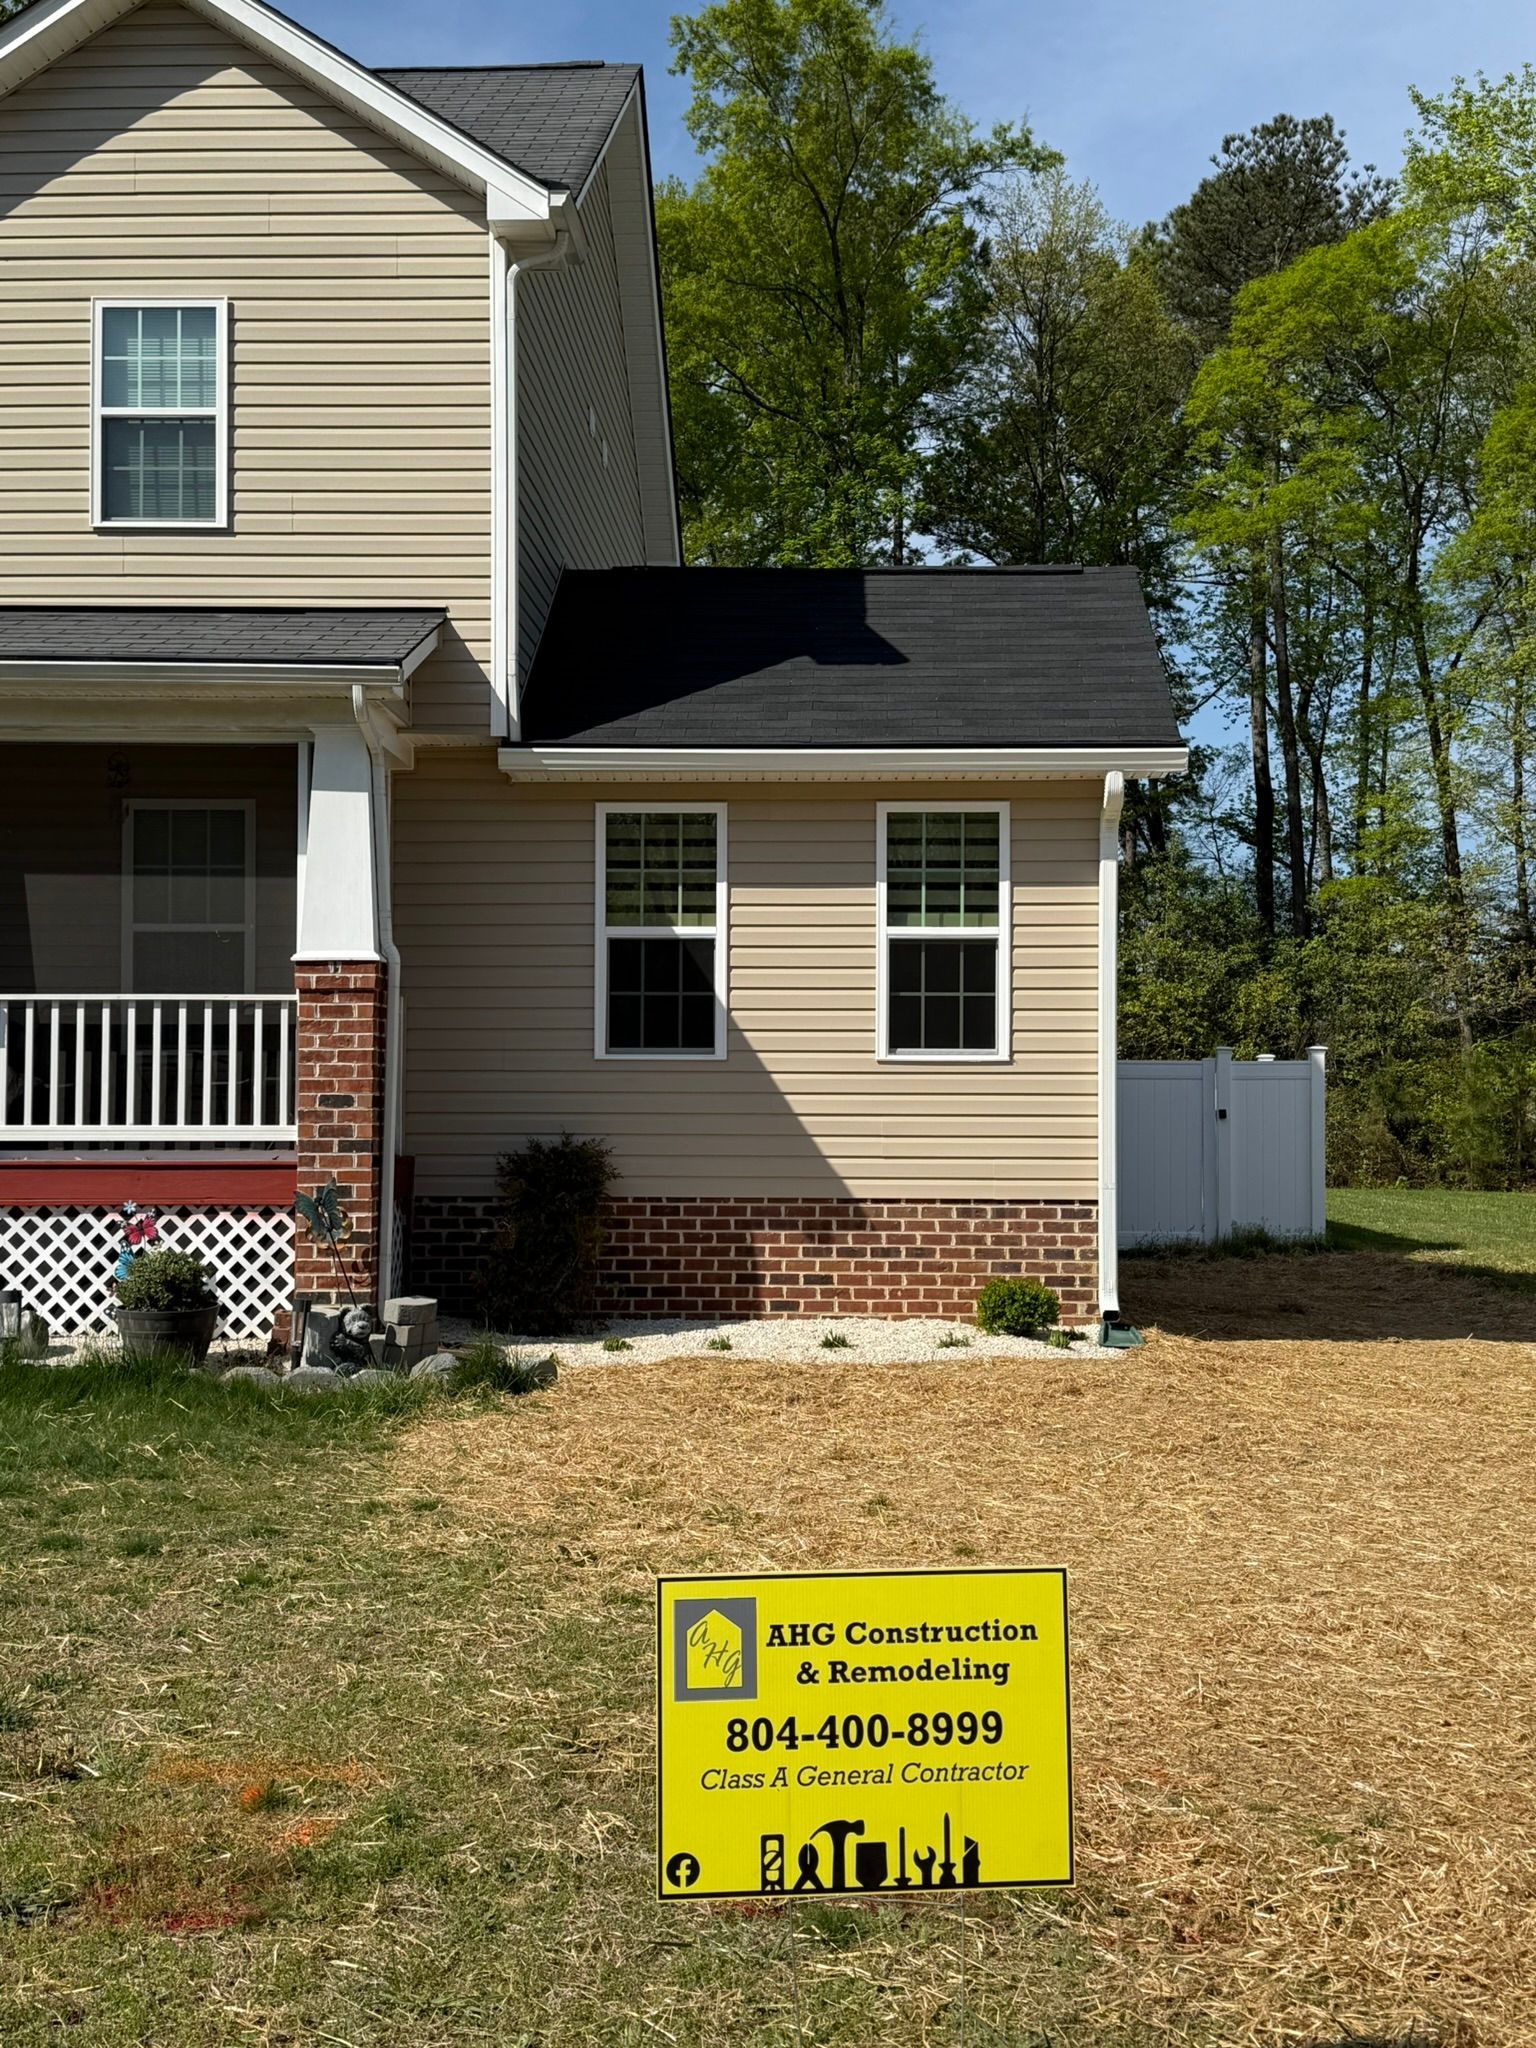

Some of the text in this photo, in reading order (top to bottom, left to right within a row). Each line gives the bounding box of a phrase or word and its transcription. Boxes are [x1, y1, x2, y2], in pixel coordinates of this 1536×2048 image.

[766, 1619, 1038, 1647] AHG Construction
[796, 1658, 1010, 1685] & Remodeling
[726, 1711, 1003, 1752] 804-400-8999
[701, 1762, 1029, 1790] Class A General Contractor
